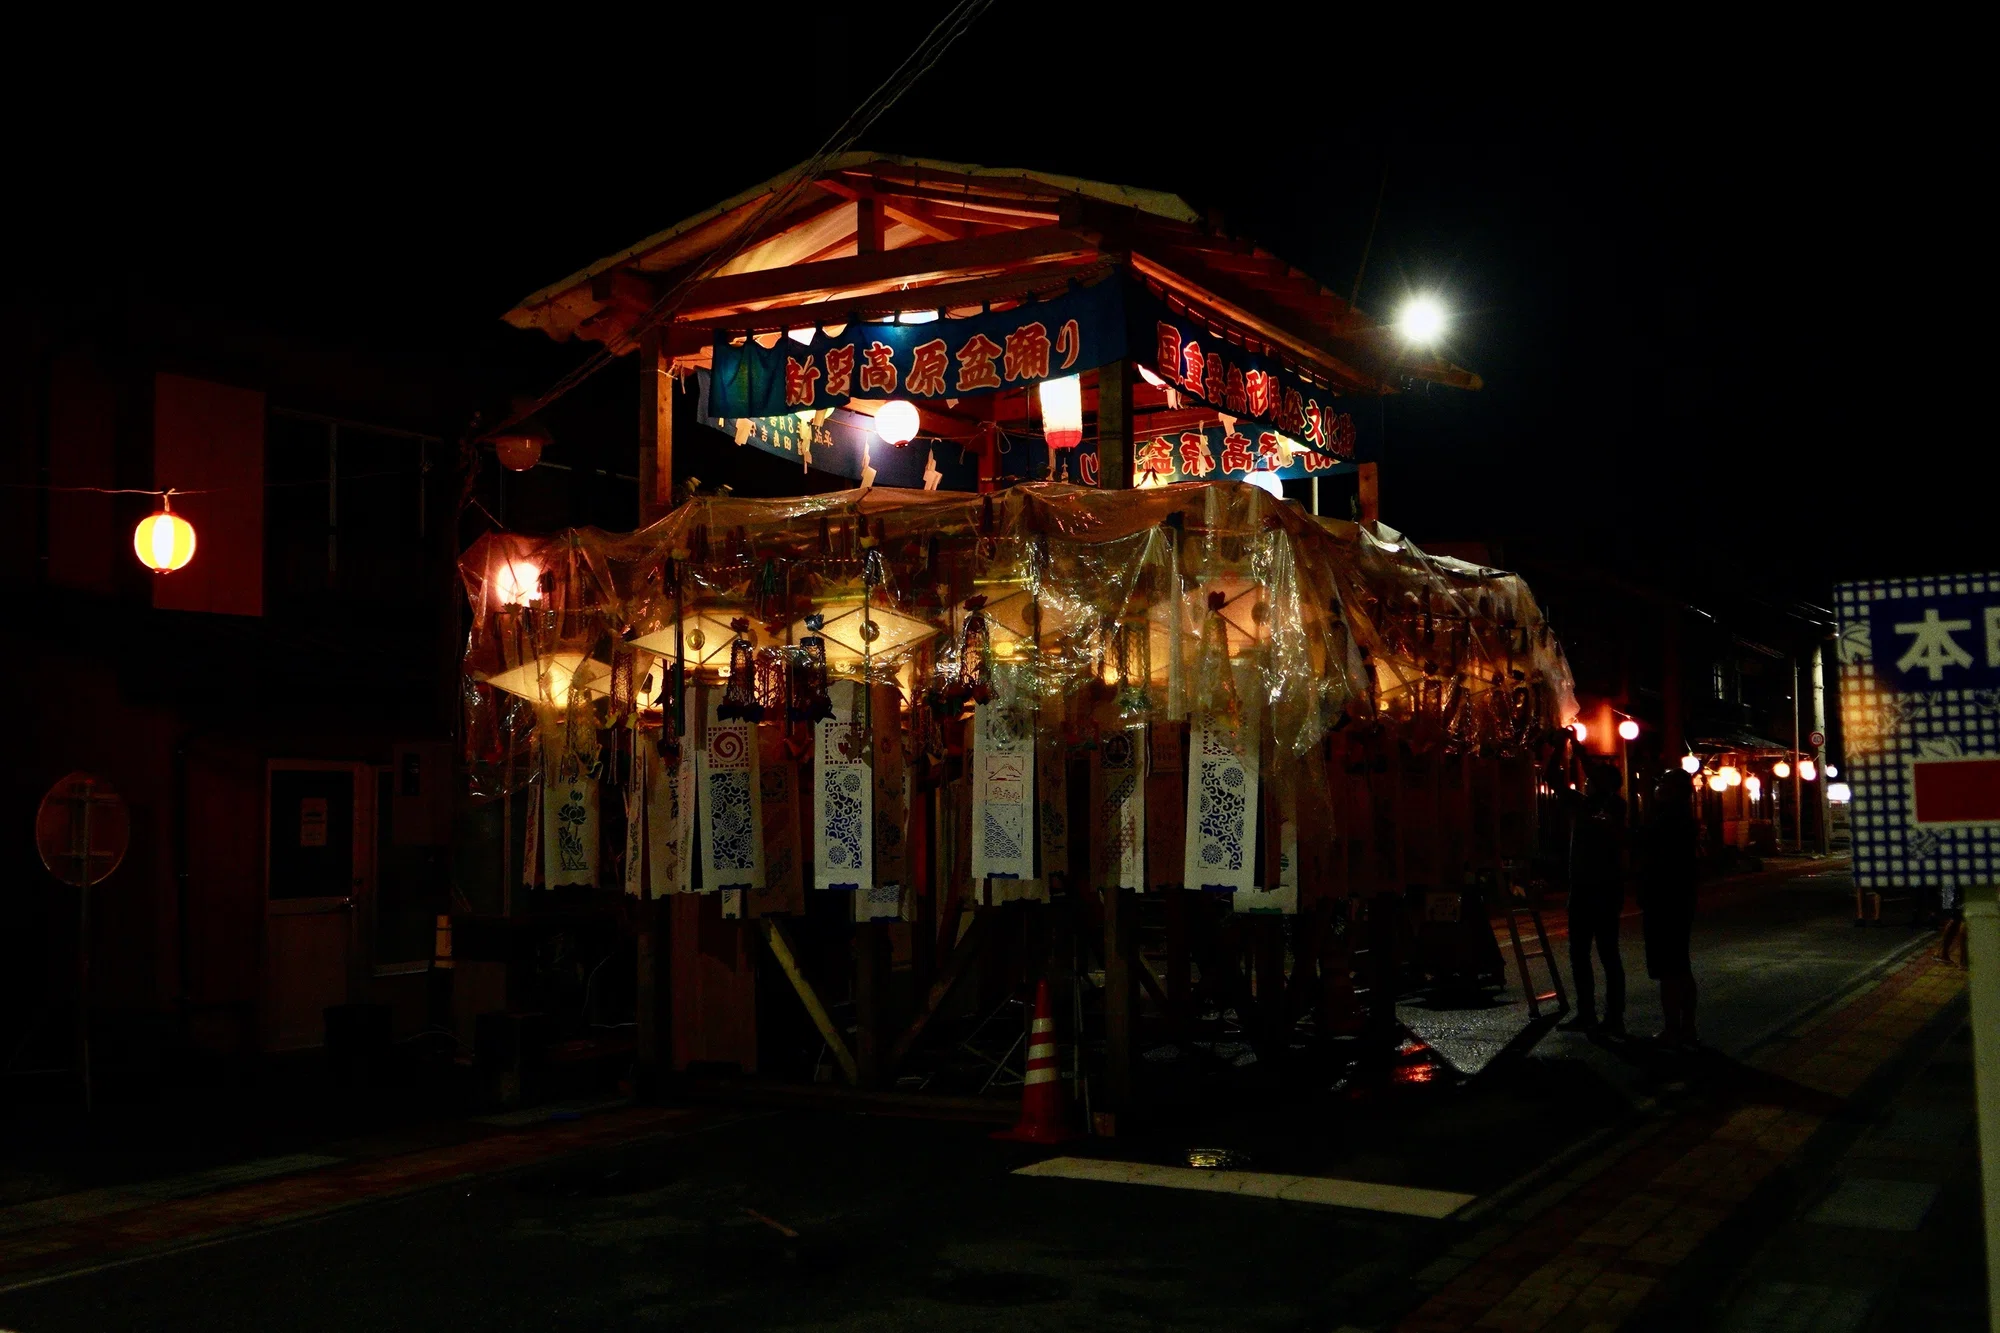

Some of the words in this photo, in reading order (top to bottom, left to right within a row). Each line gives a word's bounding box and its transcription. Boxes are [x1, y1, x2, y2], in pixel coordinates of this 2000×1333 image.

[784, 317, 1081, 407] 新野高原盆踊り
